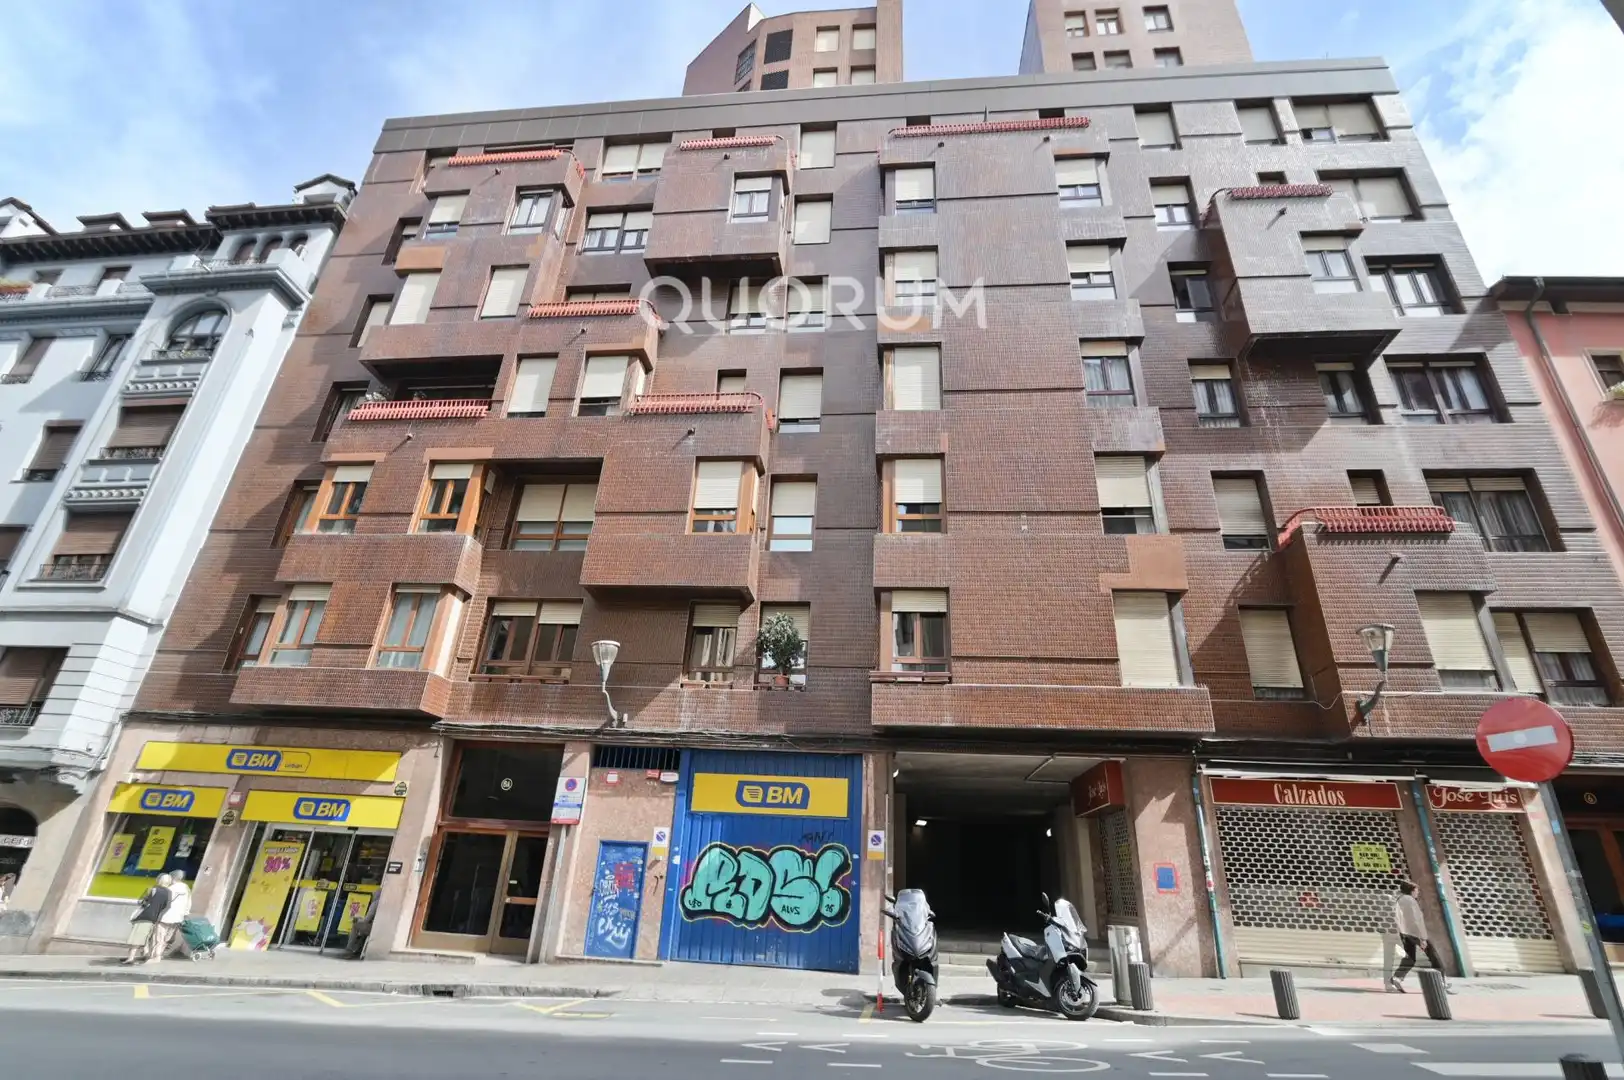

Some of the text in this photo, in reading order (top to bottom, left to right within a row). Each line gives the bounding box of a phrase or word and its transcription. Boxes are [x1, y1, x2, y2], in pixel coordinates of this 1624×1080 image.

[247, 752, 277, 768] BM
[160, 793, 191, 808] BM
[766, 786, 804, 804] BM
[1273, 783, 1346, 806] Calzados
[316, 802, 347, 817] BM
